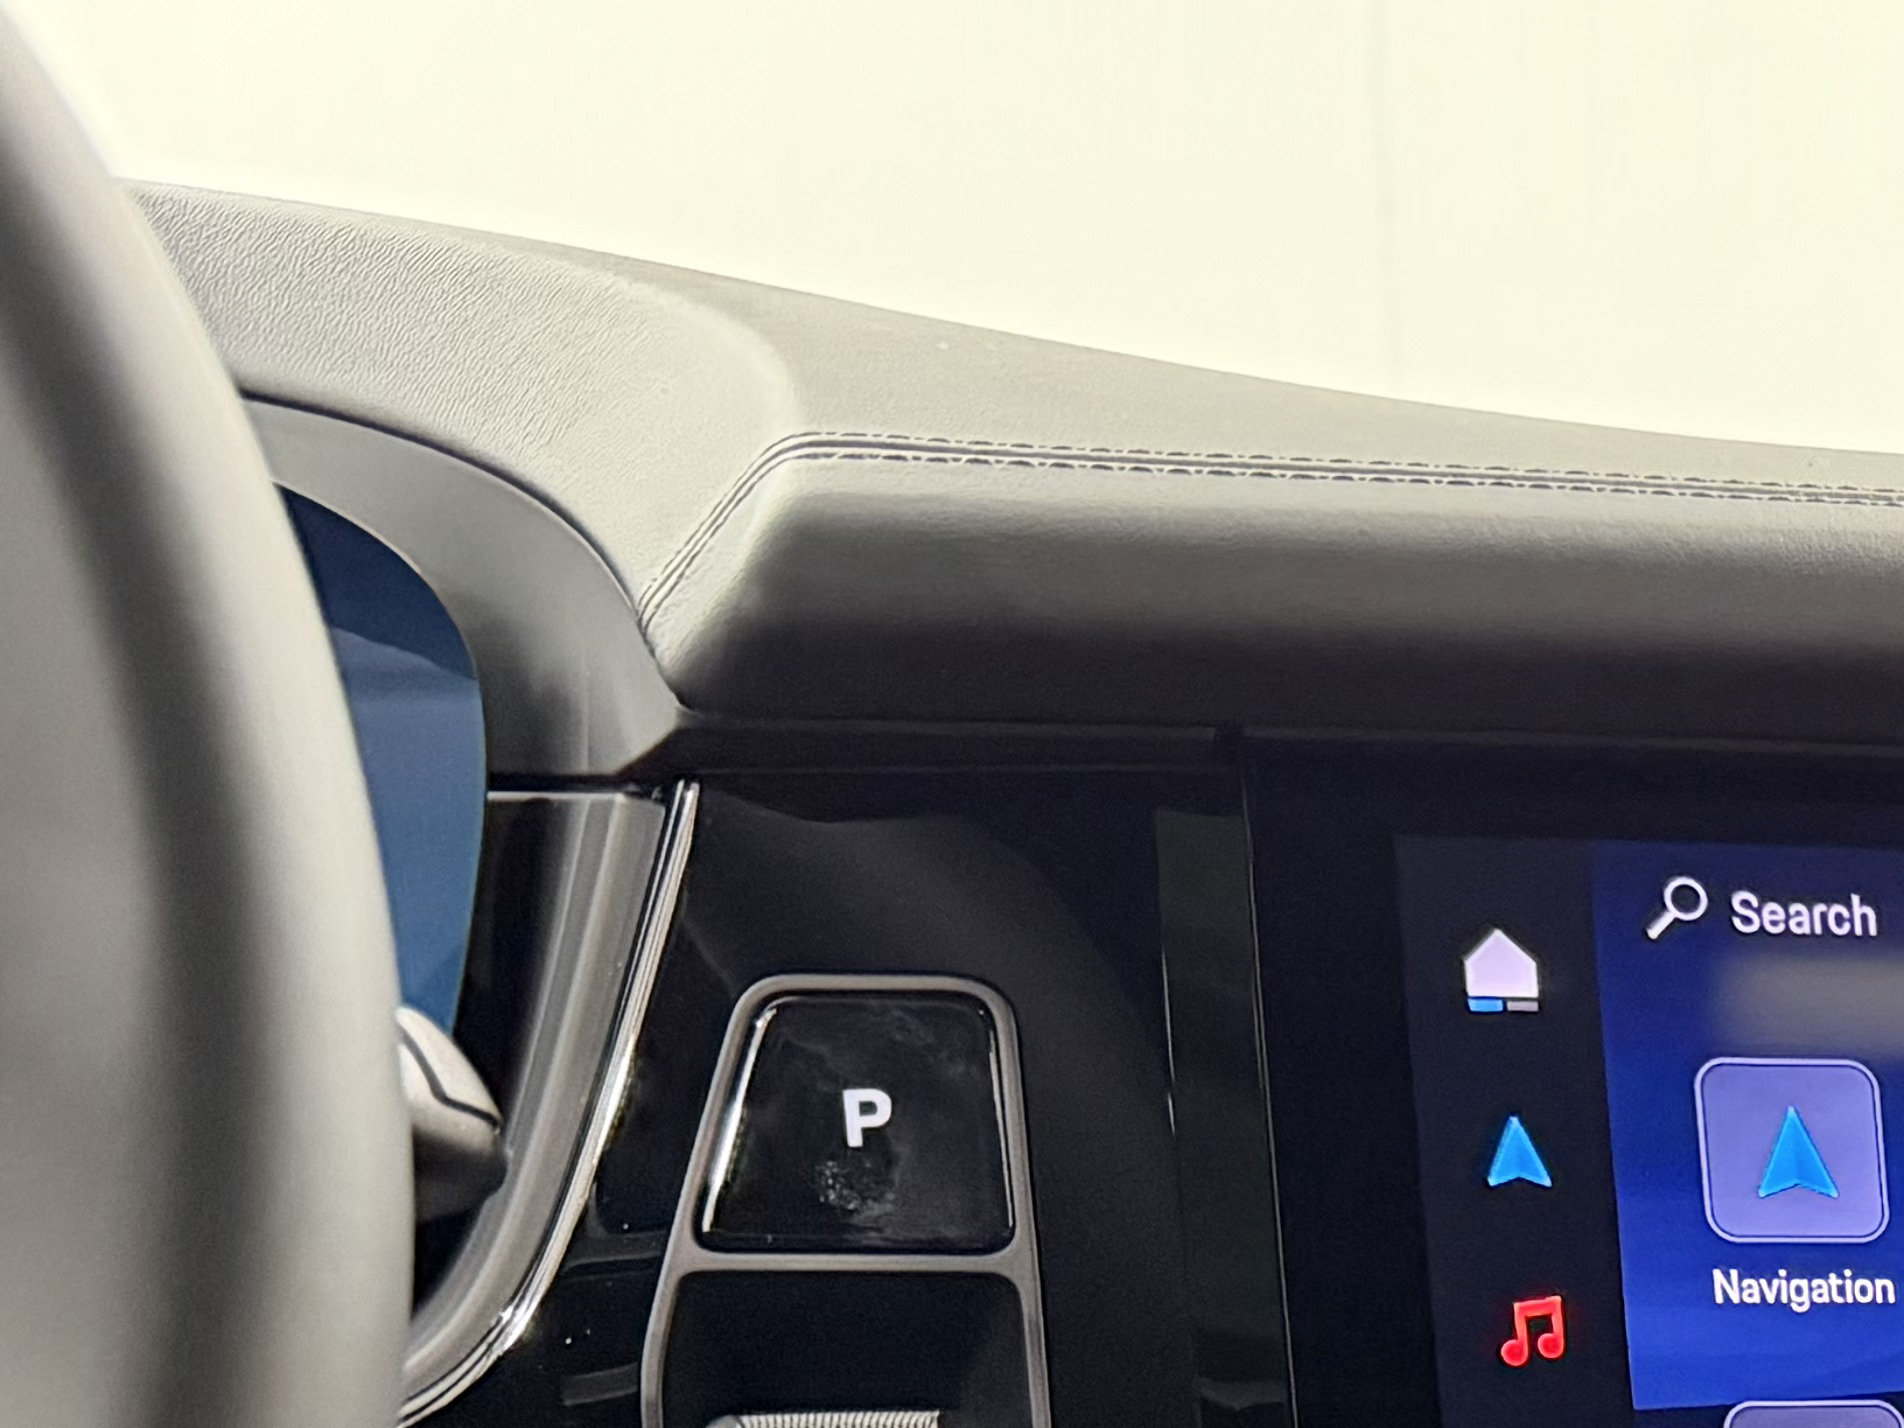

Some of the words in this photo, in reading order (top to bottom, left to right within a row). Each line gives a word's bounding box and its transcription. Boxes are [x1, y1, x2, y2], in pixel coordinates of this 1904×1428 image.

[1731, 890, 1878, 938] Search
[842, 1088, 893, 1148] P
[1712, 1268, 1896, 1313] Navigation
